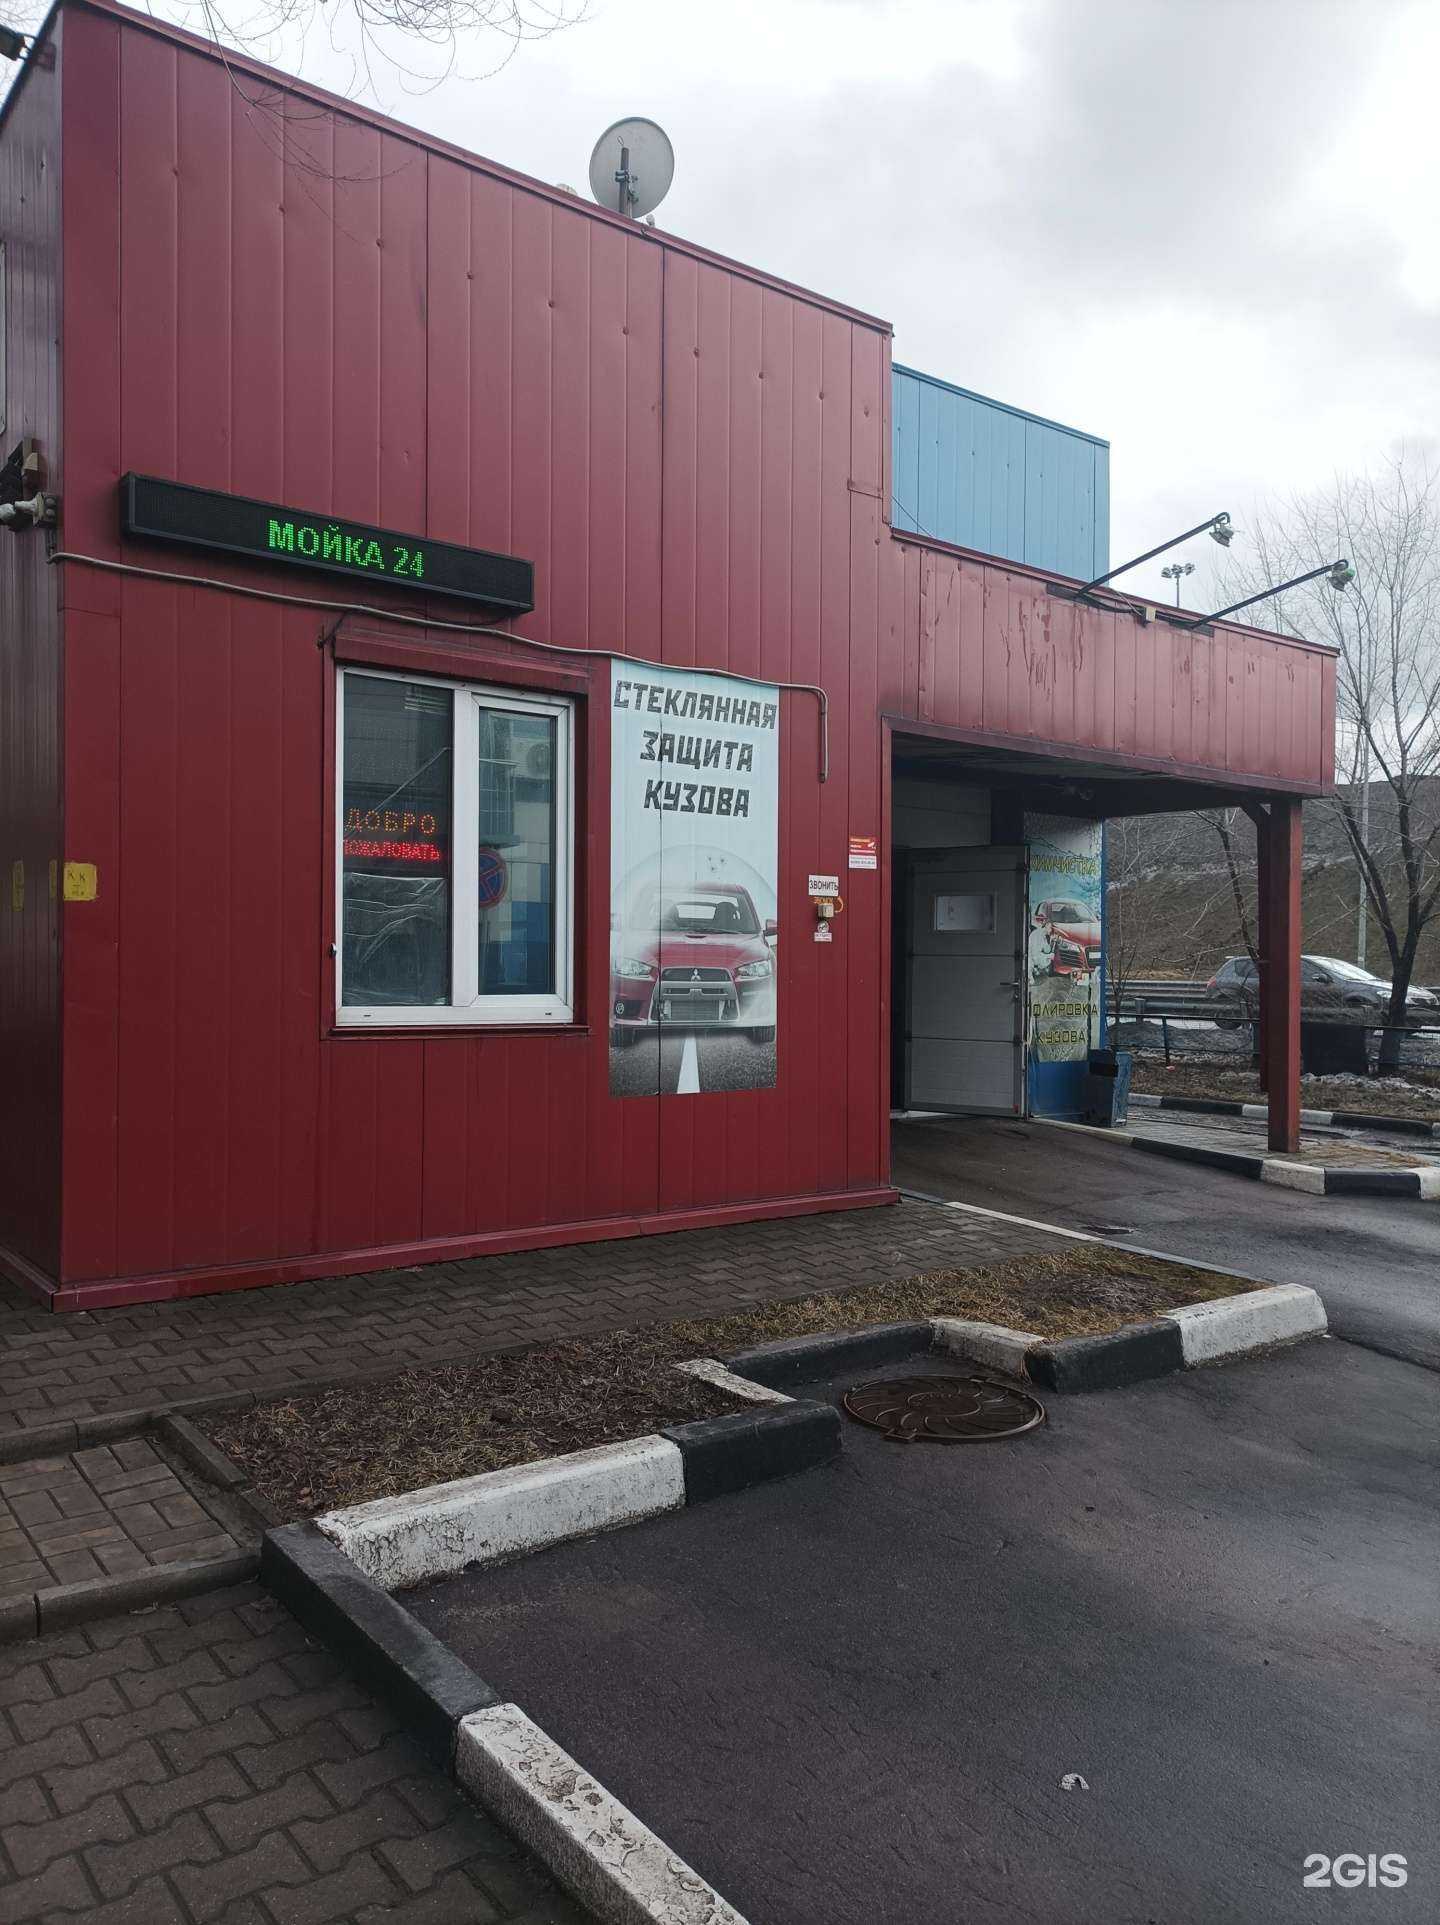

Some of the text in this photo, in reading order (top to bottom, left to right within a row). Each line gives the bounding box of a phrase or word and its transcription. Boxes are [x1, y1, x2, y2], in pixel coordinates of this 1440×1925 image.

[269, 519, 425, 577] МОЙКА 24
[613, 679, 778, 730] СТЕКЛЯННАЯ
[640, 730, 754, 772] ЗАЩИТА
[643, 779, 750, 818] КУЗОВА
[345, 807, 437, 834] ДОБРО
[809, 879, 838, 891] ЗВОНИТЬ
[1032, 1002, 1098, 1017] ОЛИРОВКА
